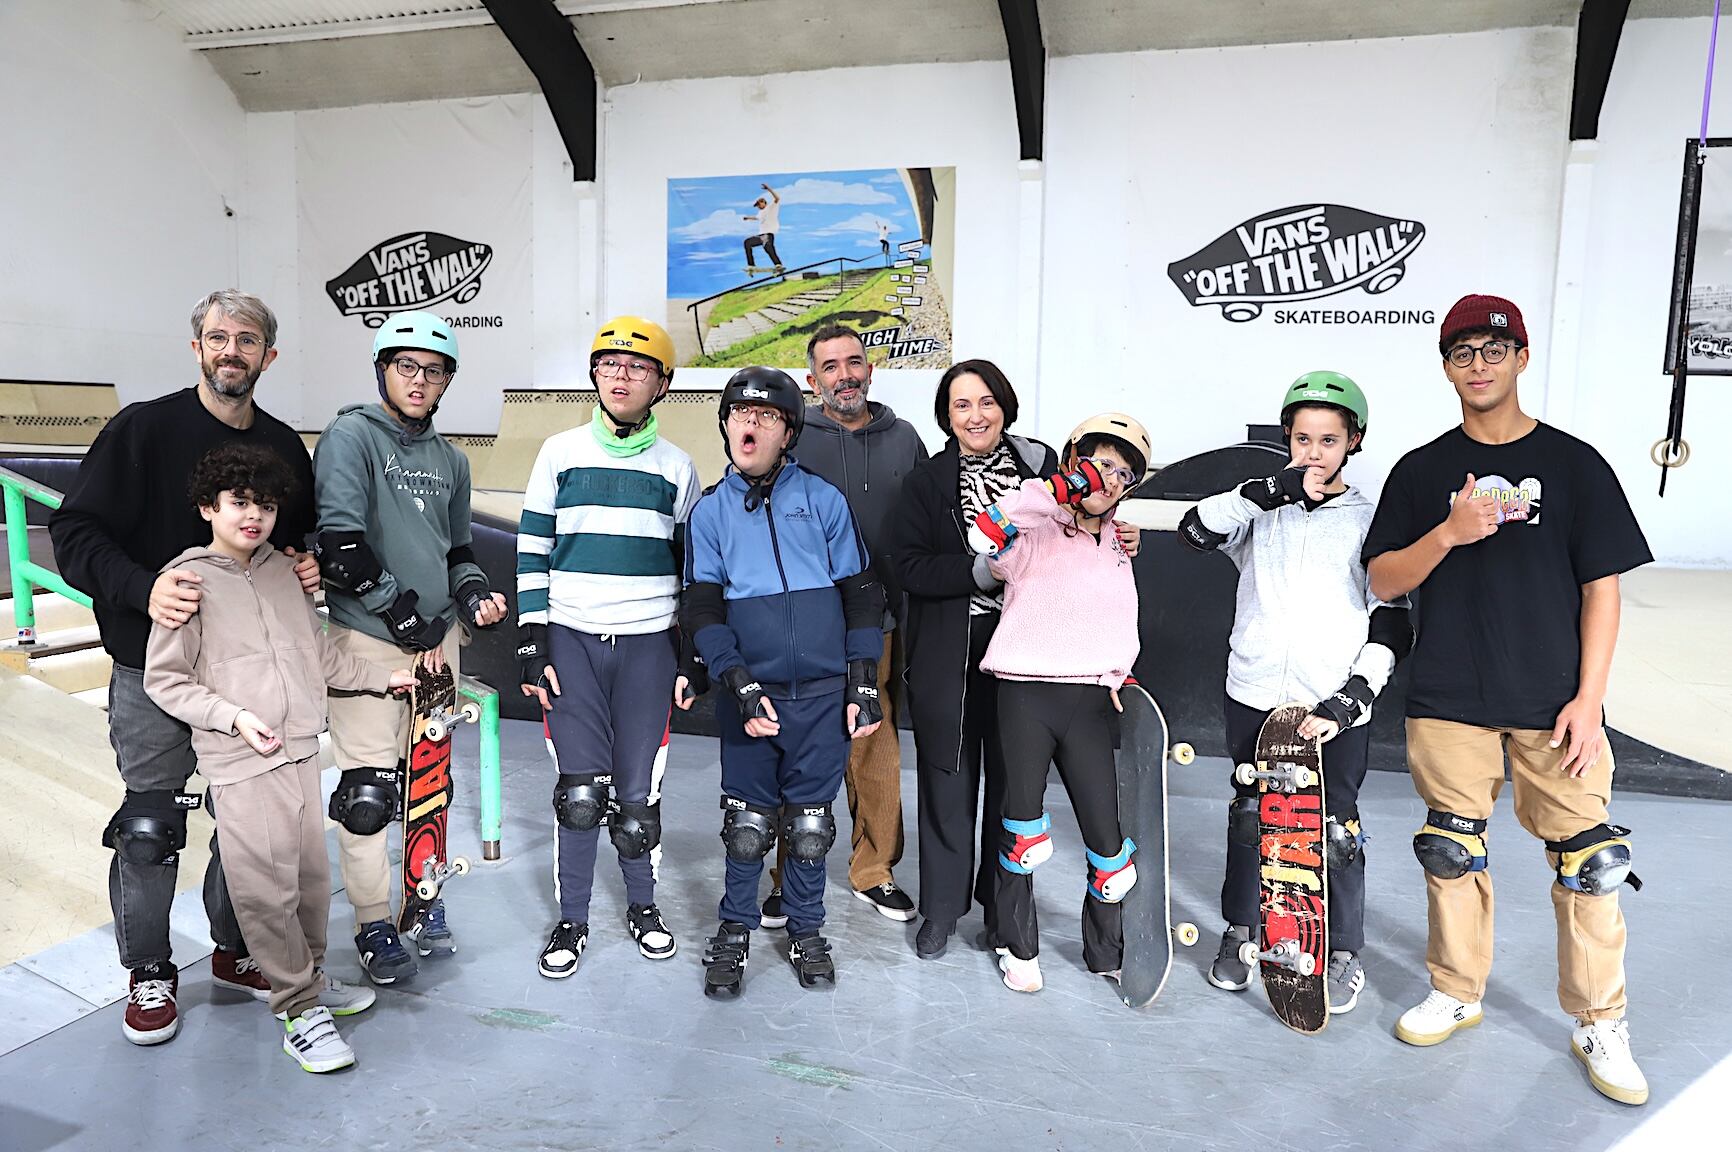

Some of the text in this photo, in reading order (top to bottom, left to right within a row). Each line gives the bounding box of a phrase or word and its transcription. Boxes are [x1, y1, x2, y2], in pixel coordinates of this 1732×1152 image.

[1236, 206, 1330, 257] VANS
[368, 233, 430, 276] VANS
[1252, 245, 1323, 294] THE
[381, 265, 428, 305] THE
[1274, 310, 1435, 324] SKATEBOARDING
[892, 340, 933, 357] TIME
